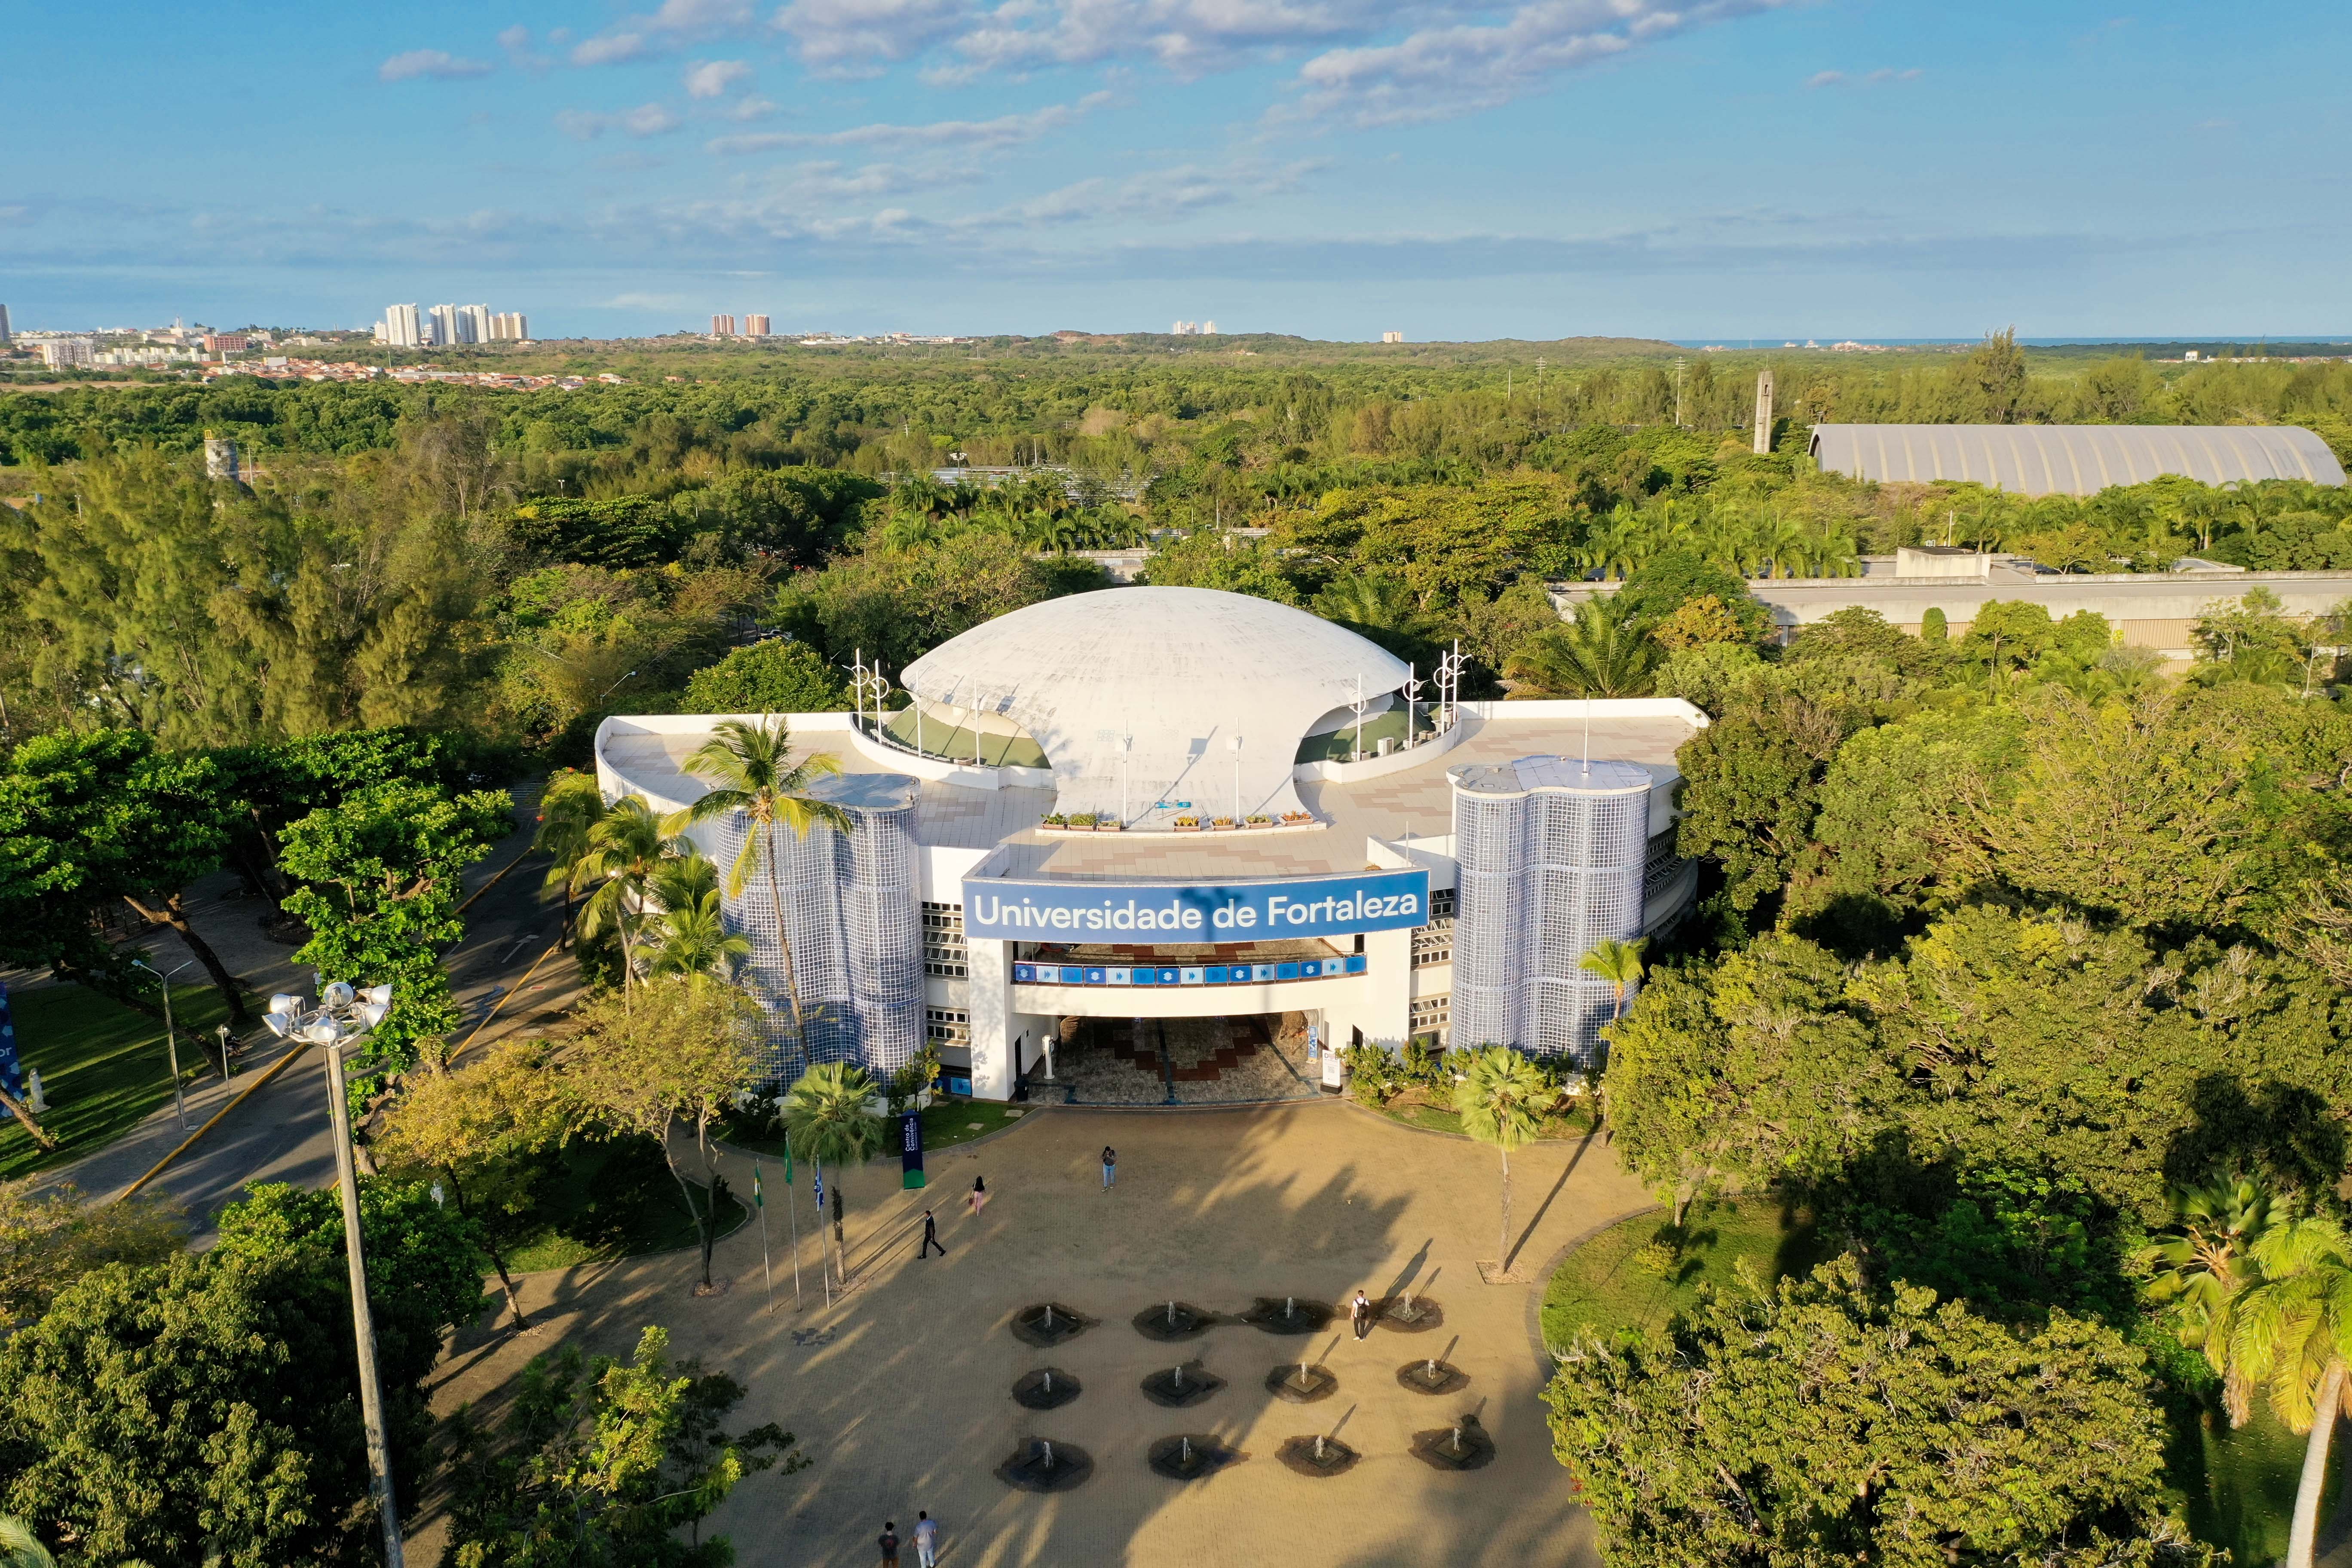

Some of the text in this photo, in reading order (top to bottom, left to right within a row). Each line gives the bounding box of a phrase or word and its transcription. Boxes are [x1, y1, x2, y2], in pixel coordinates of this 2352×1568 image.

[975, 890, 1418, 929] Universidade de Fortaleza
